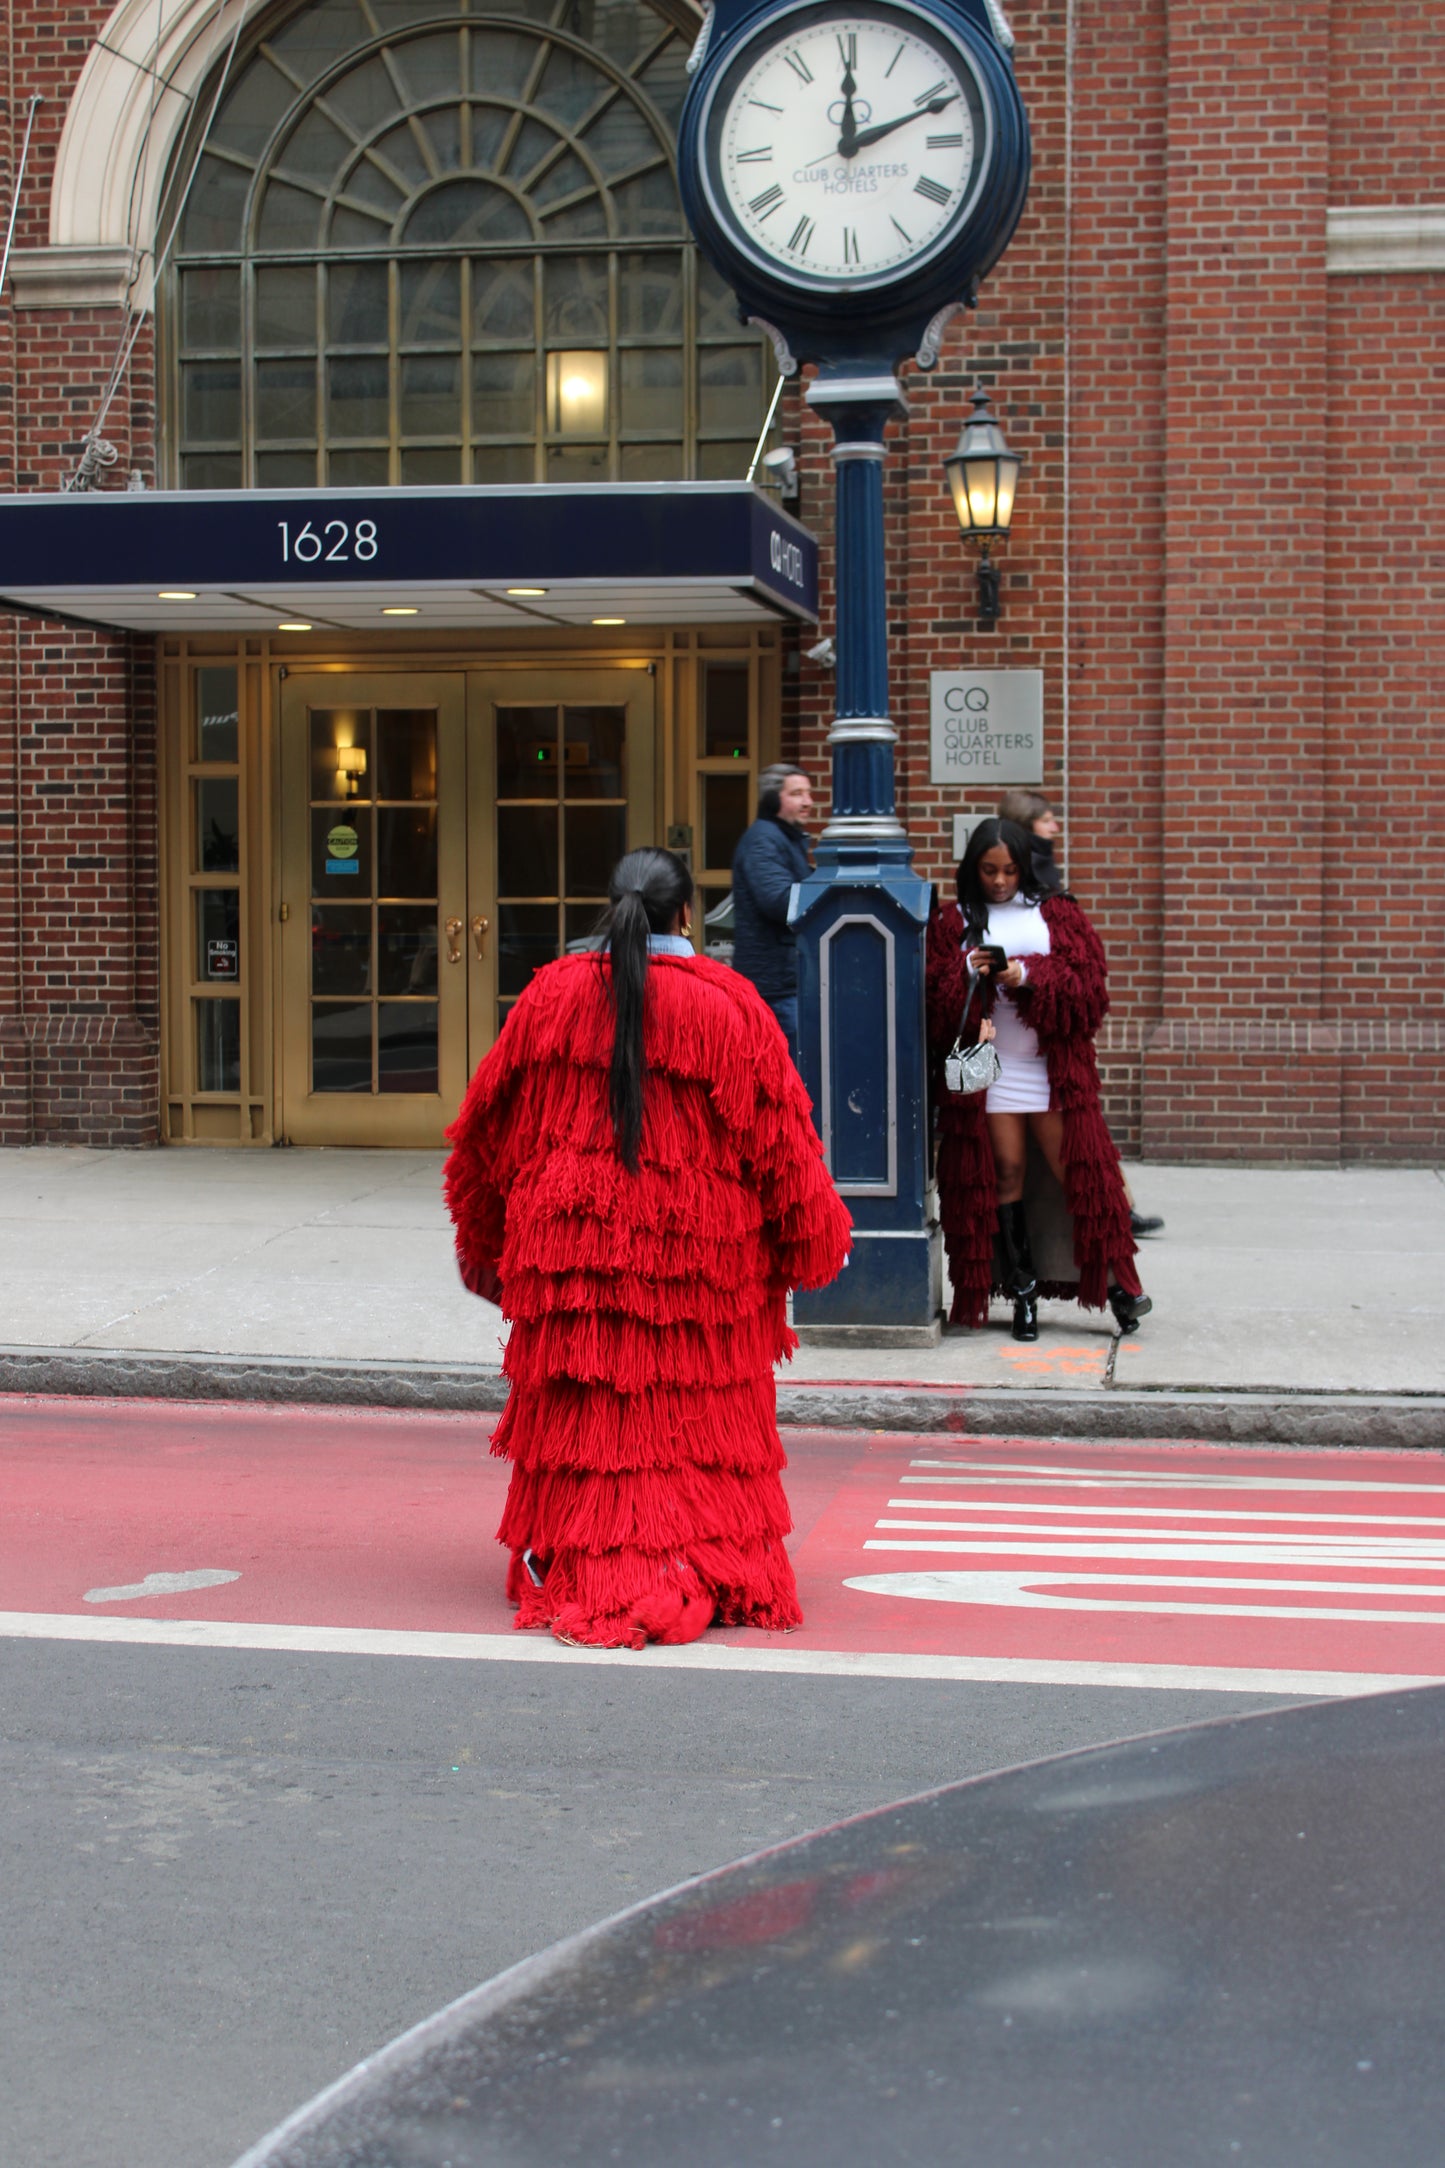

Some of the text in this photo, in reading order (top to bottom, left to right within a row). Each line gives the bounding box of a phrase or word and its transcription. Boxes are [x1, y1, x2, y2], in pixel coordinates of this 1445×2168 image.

[792, 163, 909, 184] CLUB QUARTERS
[823, 178, 878, 195] HOTELS
[278, 519, 379, 562] 1628
[782, 539, 804, 588] HOTEL
[944, 687, 990, 712] CQ
[944, 718, 989, 733] CLUB
[944, 733, 1034, 750] QUARTERS
[945, 751, 1001, 766] HOTEL
[209, 949, 237, 957] Smoking
[216, 940, 229, 950] No
